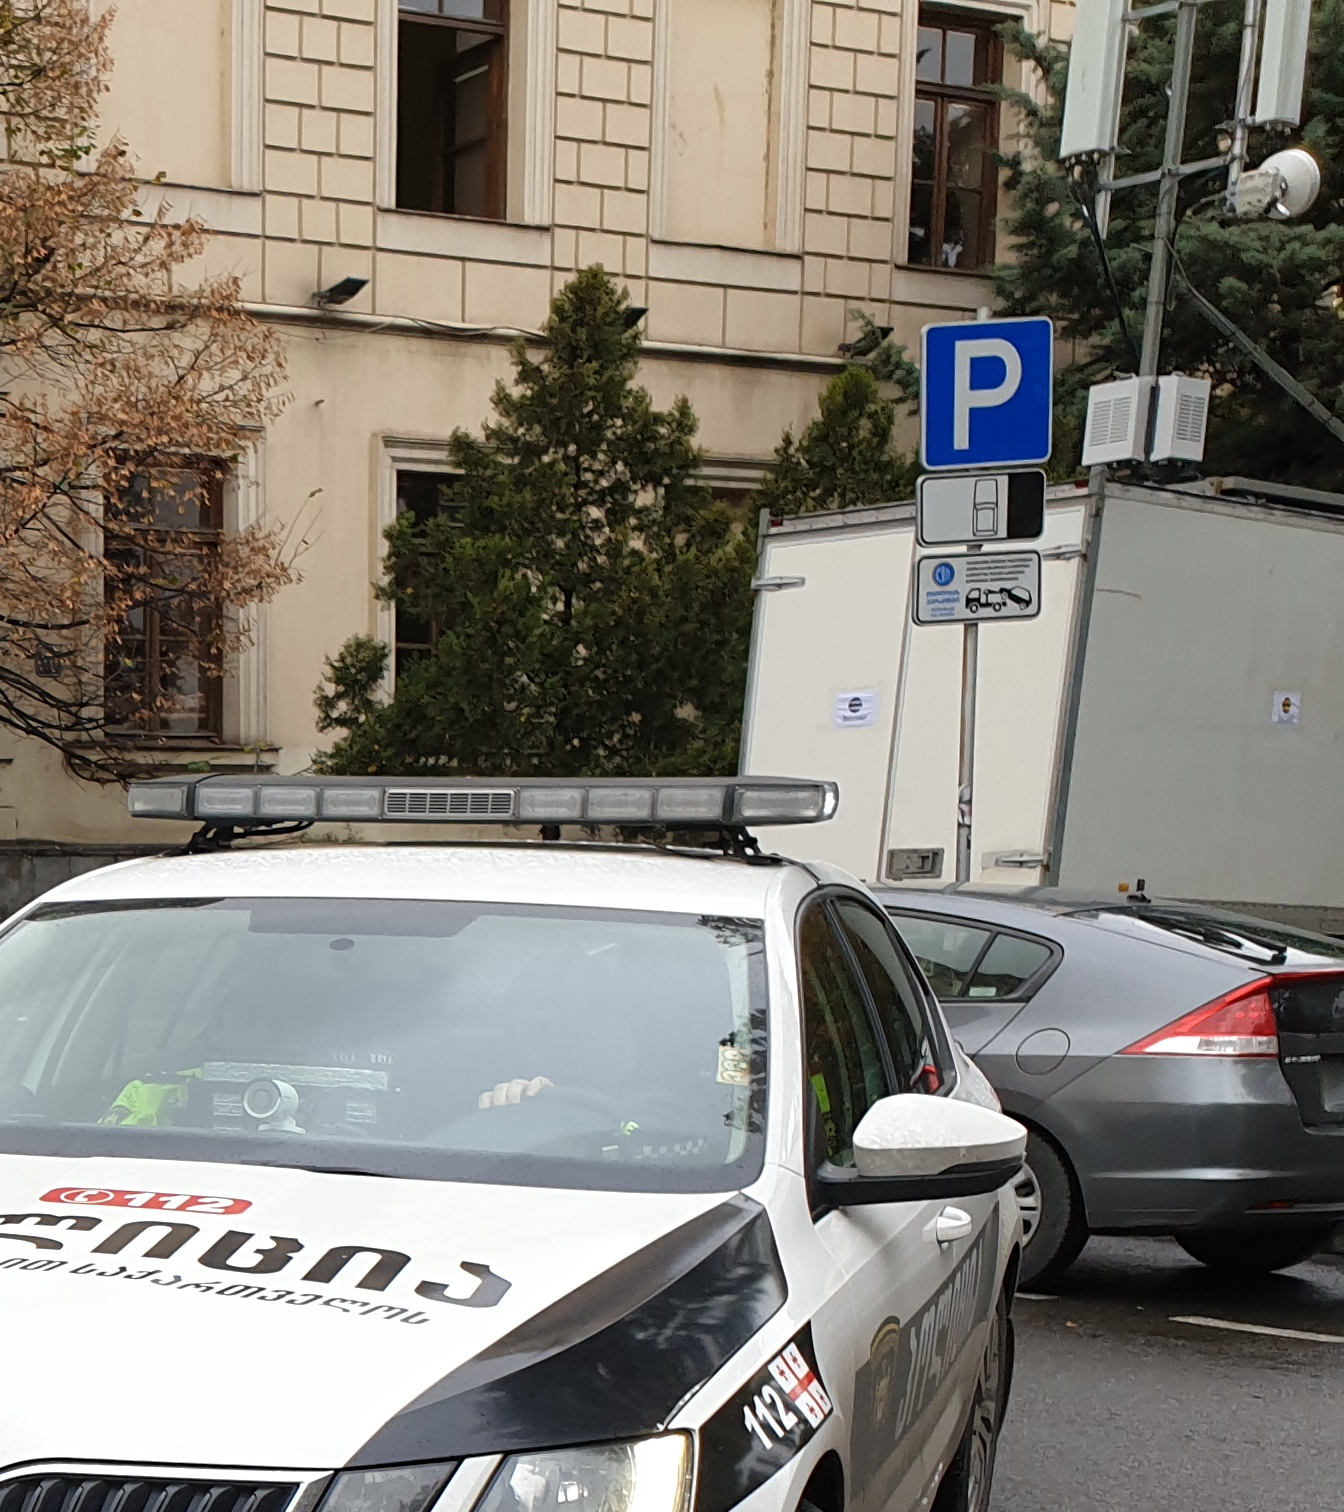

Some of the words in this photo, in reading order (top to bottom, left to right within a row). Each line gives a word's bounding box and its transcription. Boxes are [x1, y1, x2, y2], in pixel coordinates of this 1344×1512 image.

[954, 338, 1022, 451] P
[123, 1191, 236, 1215] 112
[69, 1261, 431, 1325] საქართველოს
[743, 1384, 798, 1450] 112
